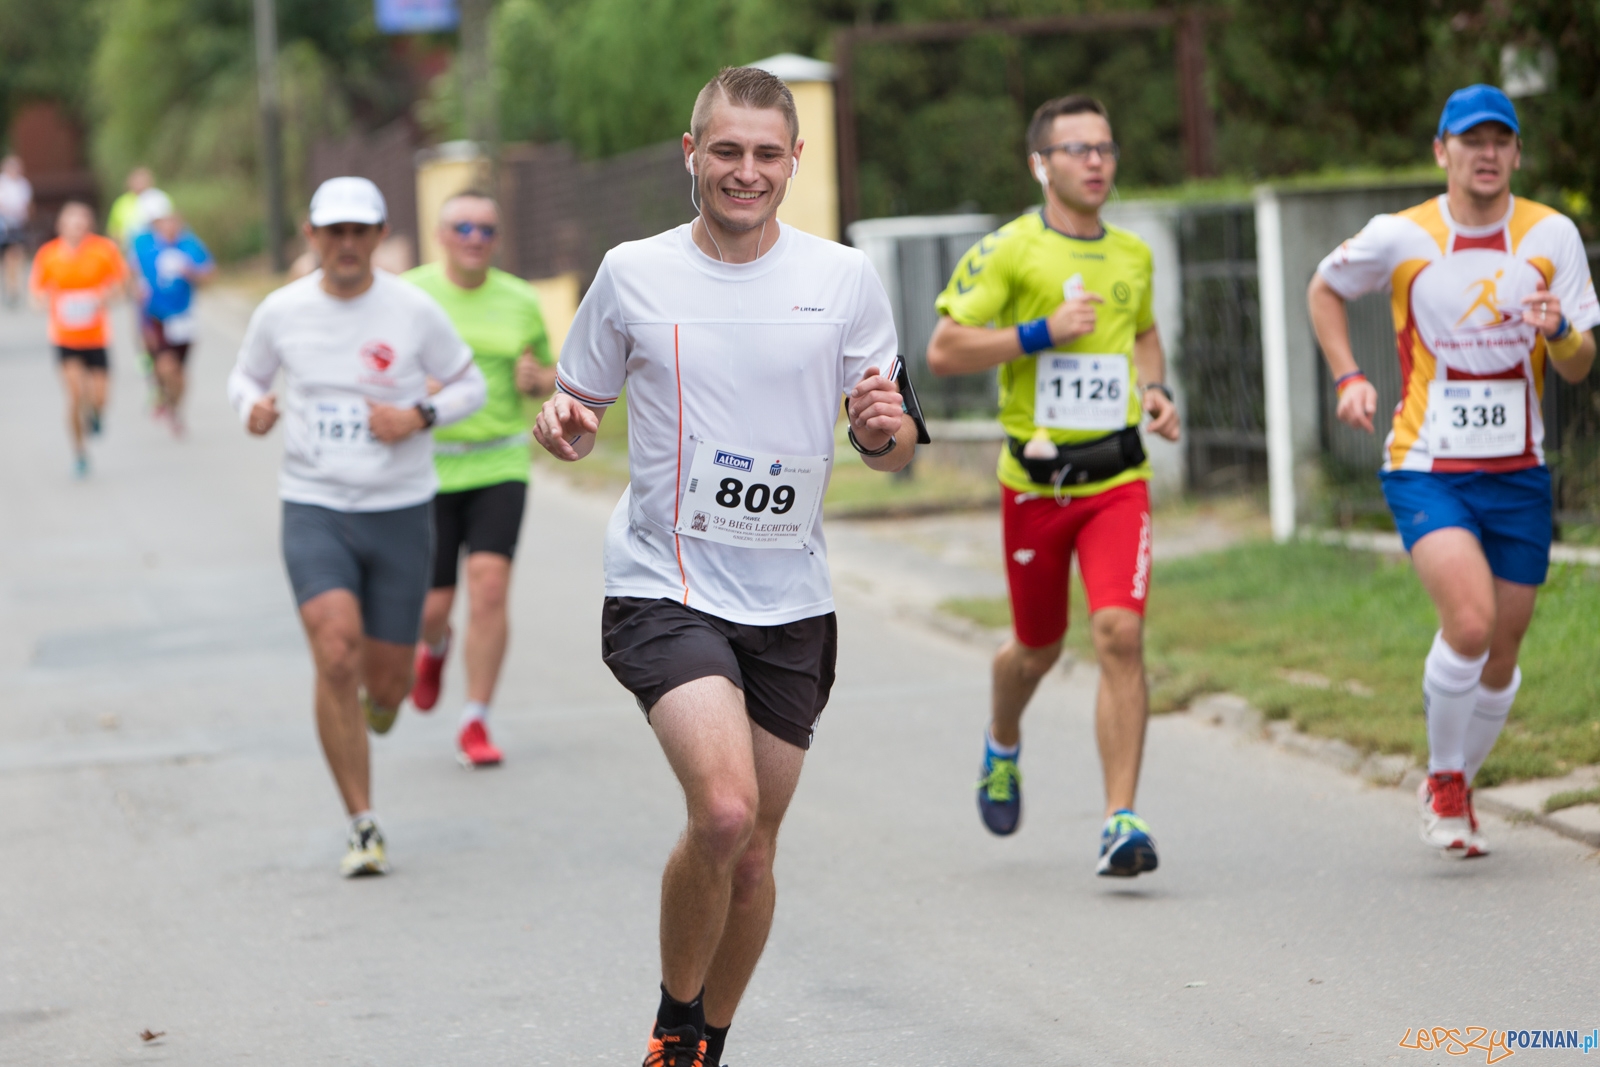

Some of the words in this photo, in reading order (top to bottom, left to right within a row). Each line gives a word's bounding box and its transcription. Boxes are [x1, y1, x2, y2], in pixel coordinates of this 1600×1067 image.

[1050, 377, 1121, 400] 1126
[1452, 404, 1506, 428] 338
[715, 477, 796, 515] 809
[713, 515, 726, 526] 39
[728, 519, 753, 531] BIEG
[755, 522, 802, 532] LECHITÓW
